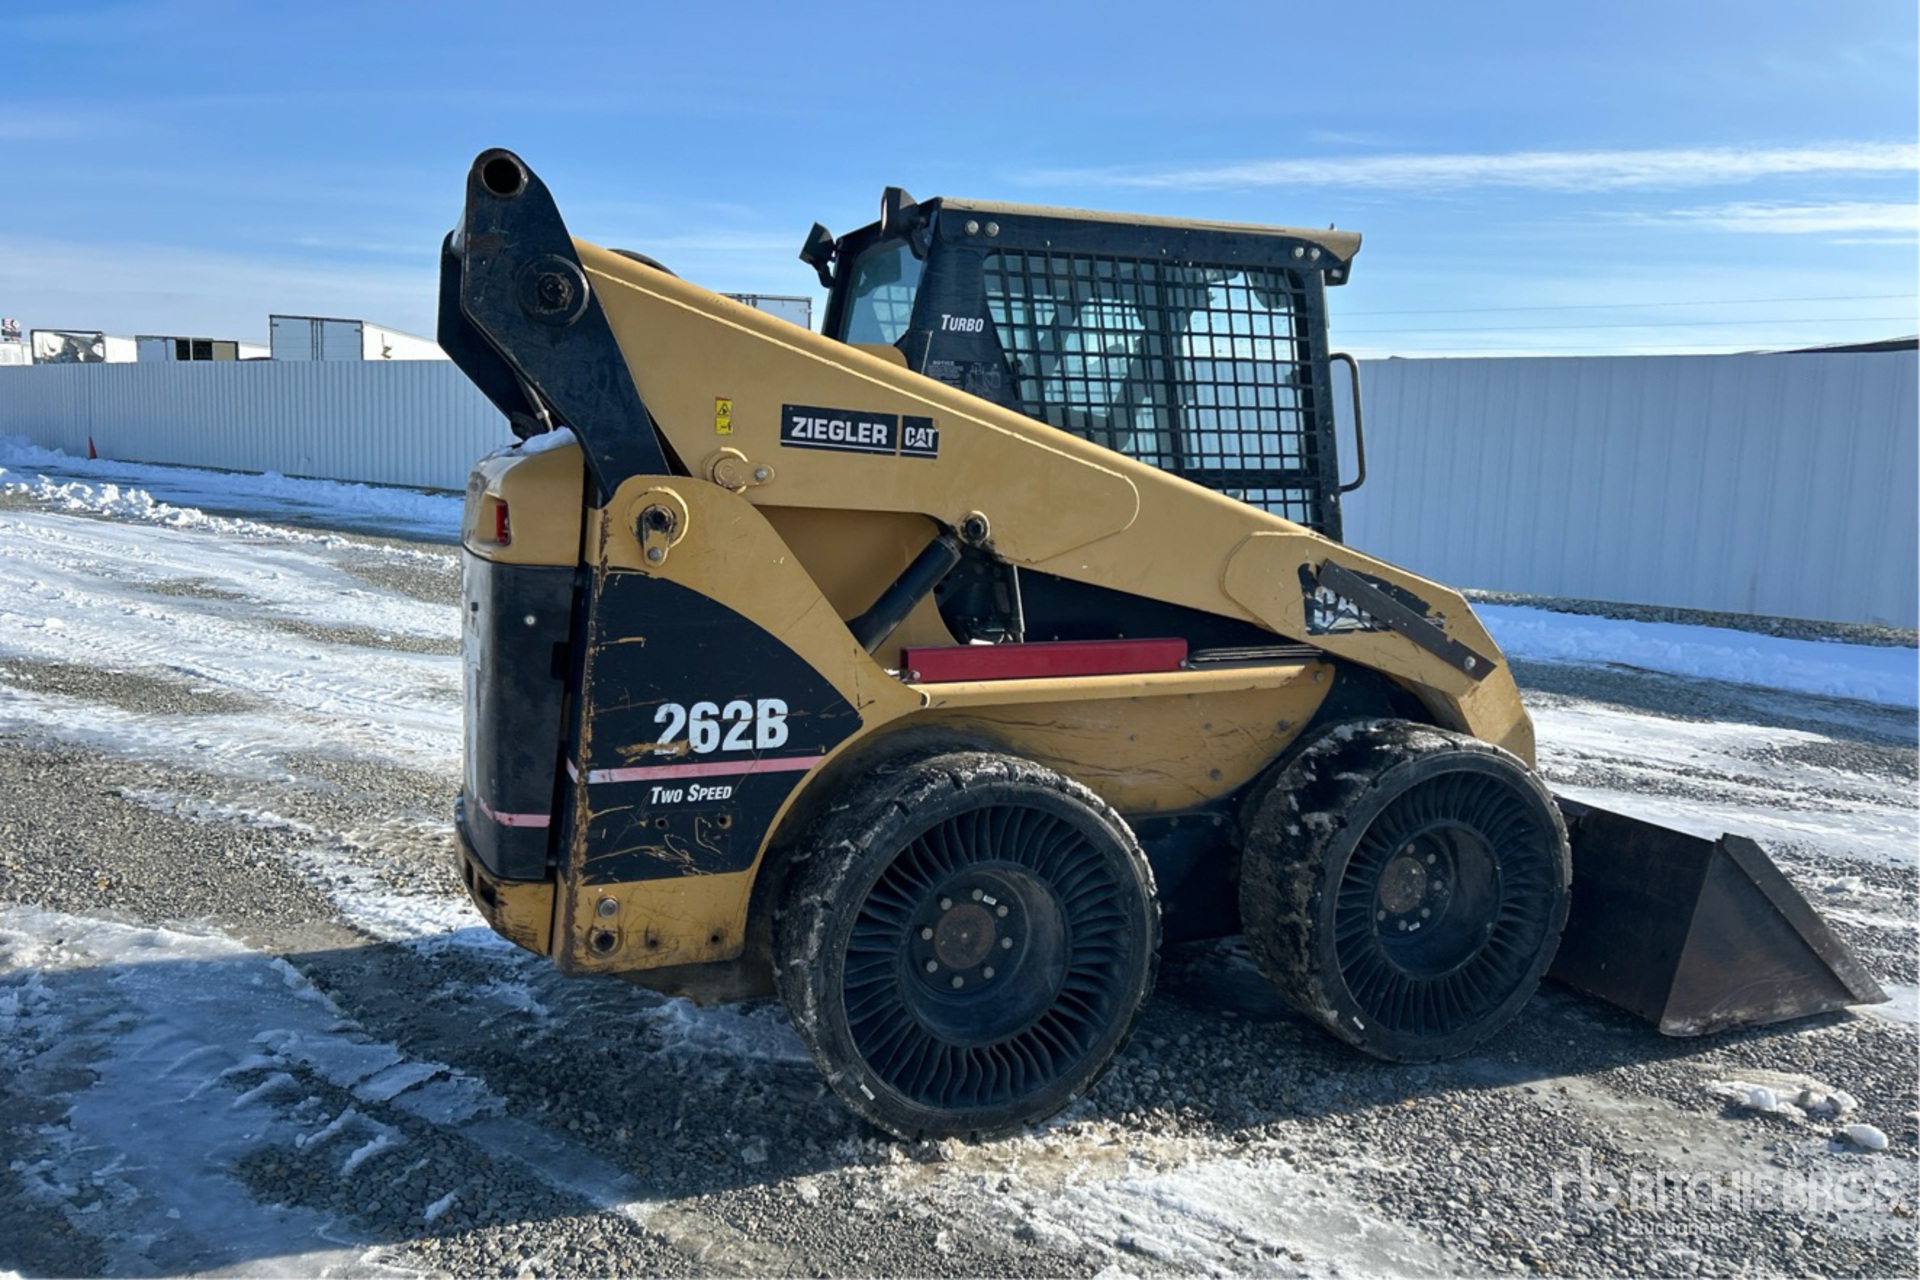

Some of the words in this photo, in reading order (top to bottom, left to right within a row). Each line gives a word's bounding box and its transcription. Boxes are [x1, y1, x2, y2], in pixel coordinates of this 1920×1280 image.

[940, 314, 985, 333] TURBO
[791, 416, 887, 445] ZIEGLER
[904, 426, 936, 449] CAT
[653, 698, 789, 755] 262B
[651, 786, 683, 804] TWO
[687, 784, 733, 802] SPEED
